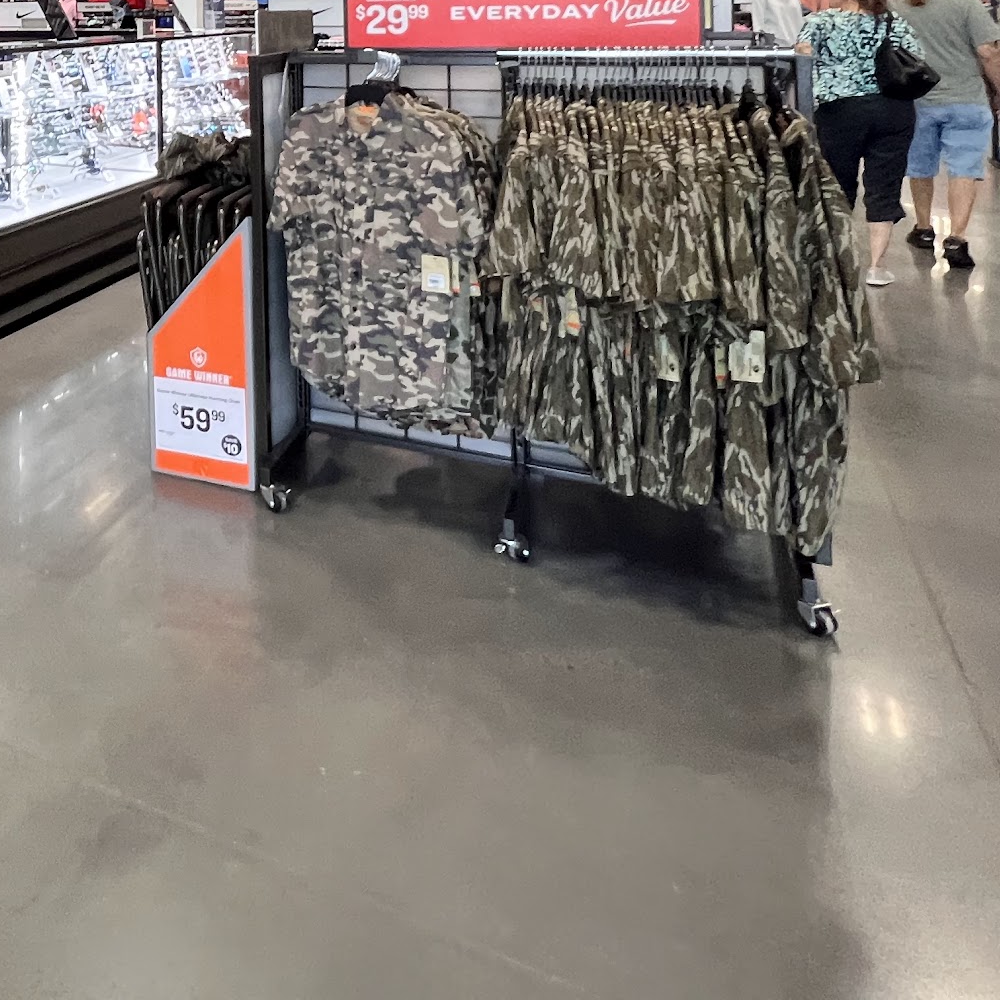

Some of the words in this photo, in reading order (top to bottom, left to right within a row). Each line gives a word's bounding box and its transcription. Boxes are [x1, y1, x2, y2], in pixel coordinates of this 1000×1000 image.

[450, 3, 599, 21] EVERYDAY
[166, 366, 192, 380] GAME
[194, 370, 230, 386] WINNER
